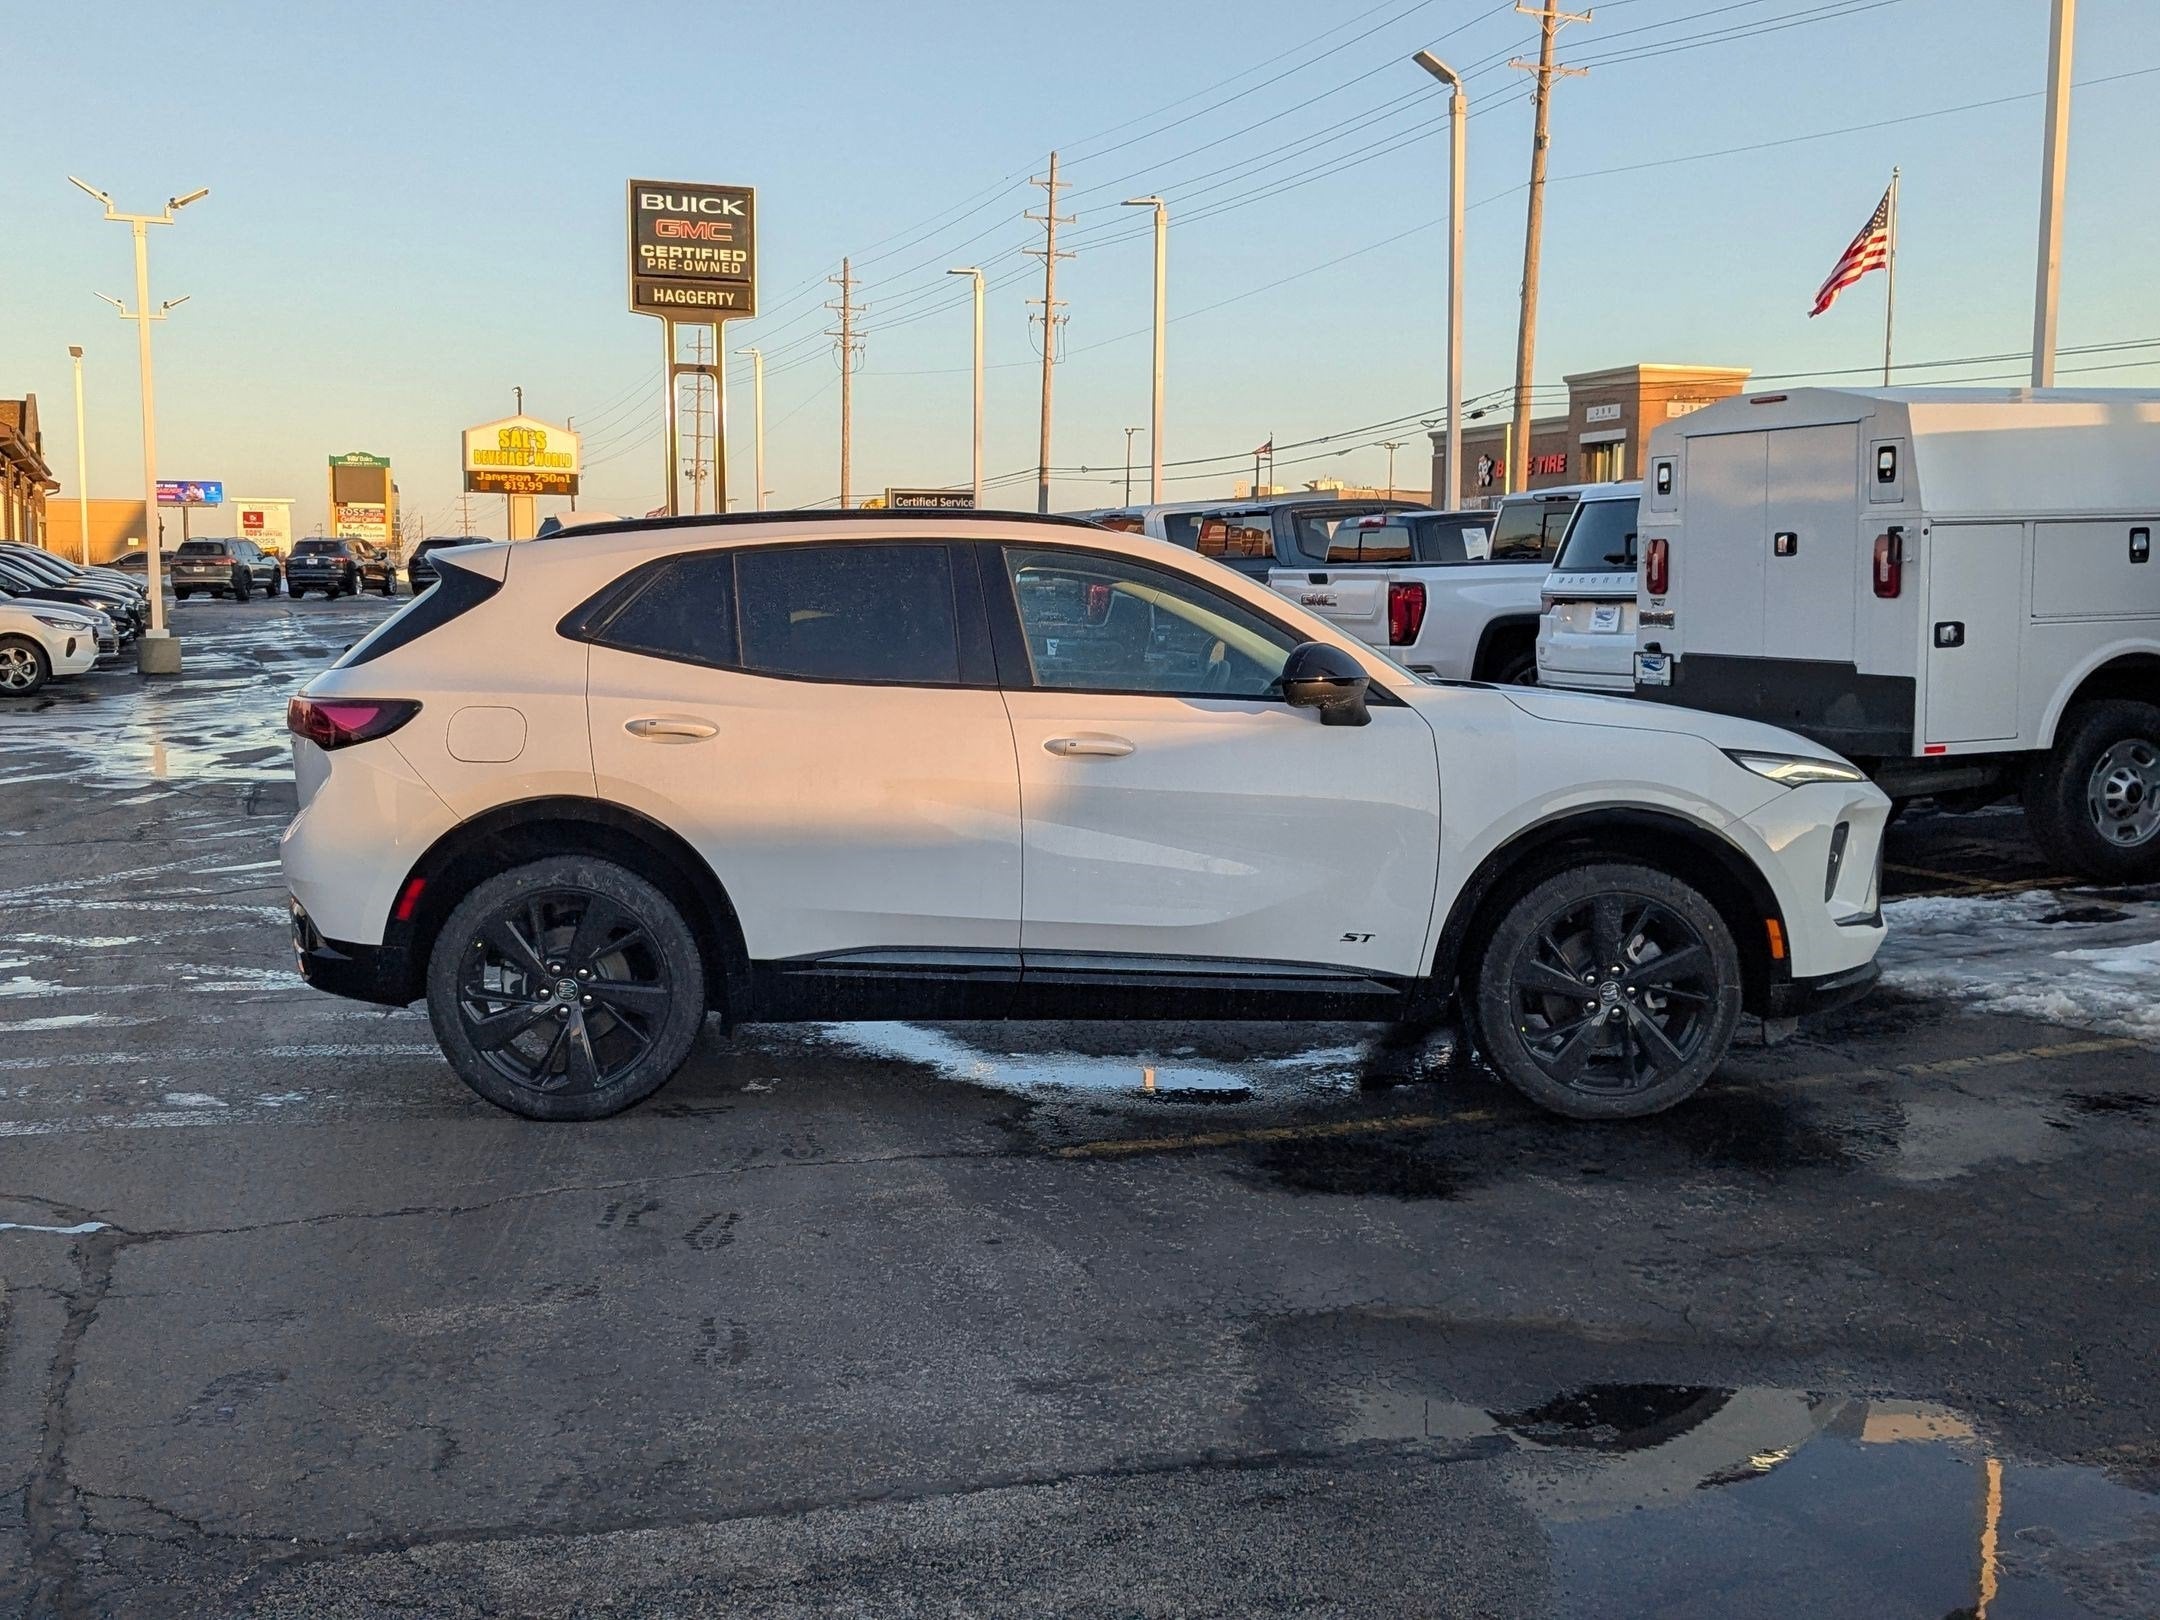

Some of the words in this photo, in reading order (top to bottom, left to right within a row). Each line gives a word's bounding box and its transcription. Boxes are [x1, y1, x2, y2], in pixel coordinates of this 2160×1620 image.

[641, 193, 745, 216] BUICK
[656, 219, 733, 241] GMC
[640, 245, 747, 262] CERTIFIED
[647, 259, 741, 273] PRE-OWNED
[654, 288, 734, 306] HAGGERTY
[498, 429, 547, 450] SAL'S
[474, 449, 530, 466] BEVERAGE
[534, 452, 572, 468] WORLD
[1537, 454, 1566, 474] TIRE
[477, 472, 532, 481] Jameson
[534, 474, 571, 483] 750ml
[504, 481, 543, 491] $19.99
[896, 497, 937, 507] Certified
[940, 498, 974, 507] Service
[339, 508, 365, 516] ROSS
[1558, 576, 1636, 584] WAGONEE
[1301, 593, 1337, 606] GMC
[1340, 933, 1376, 942] ST
